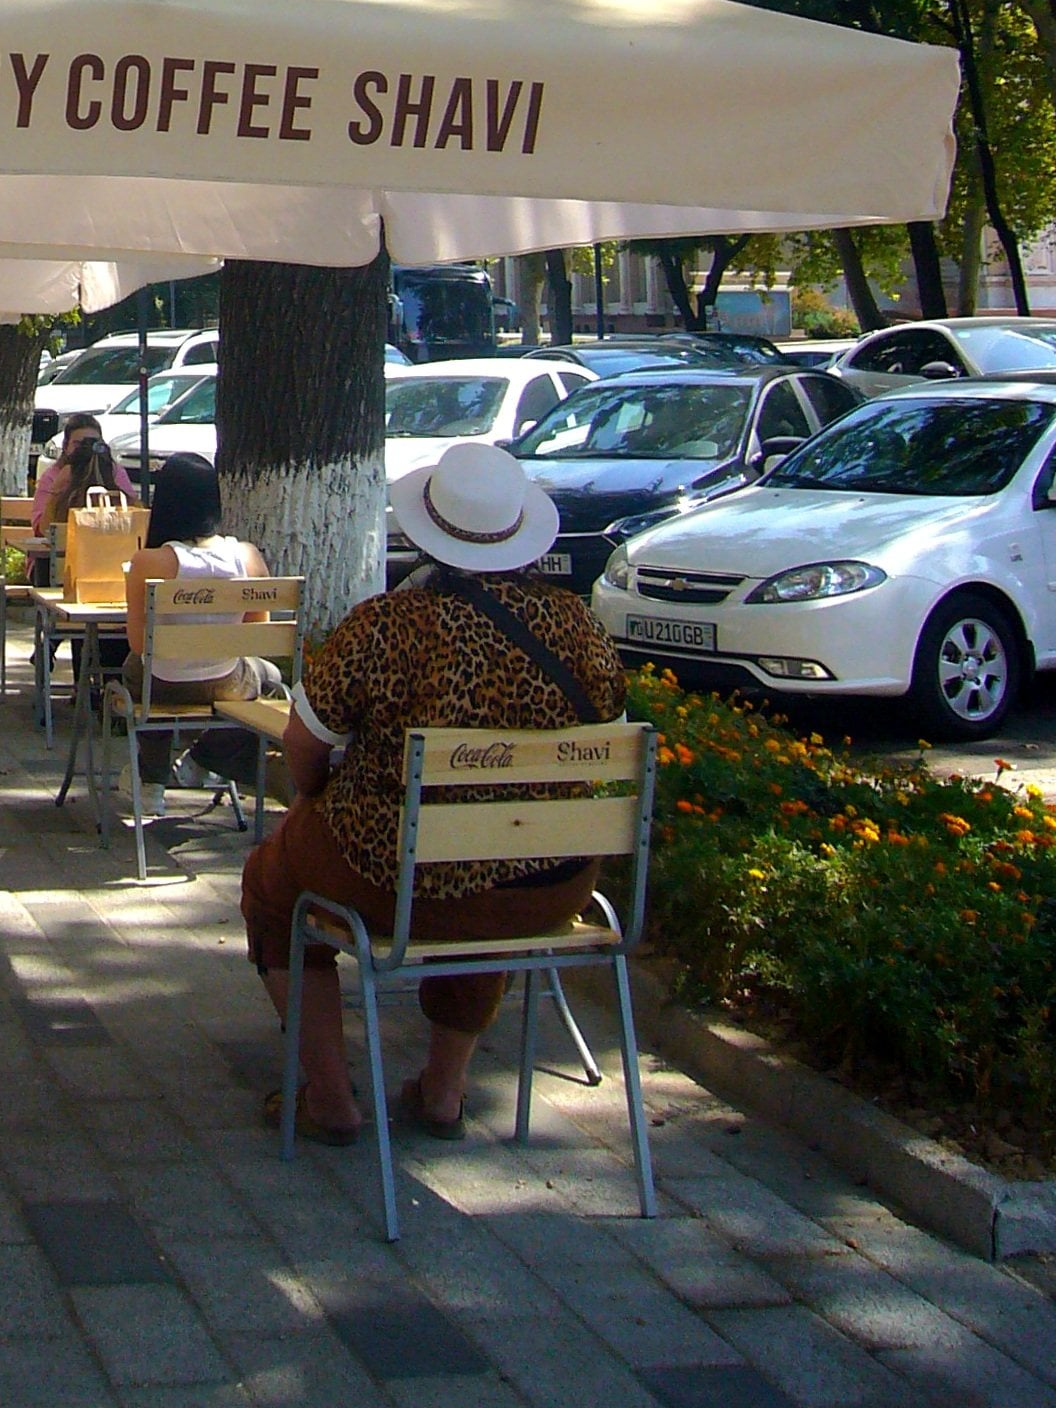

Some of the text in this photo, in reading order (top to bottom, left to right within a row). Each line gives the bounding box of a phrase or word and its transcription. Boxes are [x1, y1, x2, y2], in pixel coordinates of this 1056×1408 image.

[65, 54, 320, 141] COFFEE
[348, 71, 544, 154] SHAVI
[242, 588, 277, 600] Shavi
[557, 741, 610, 761] Shavi
